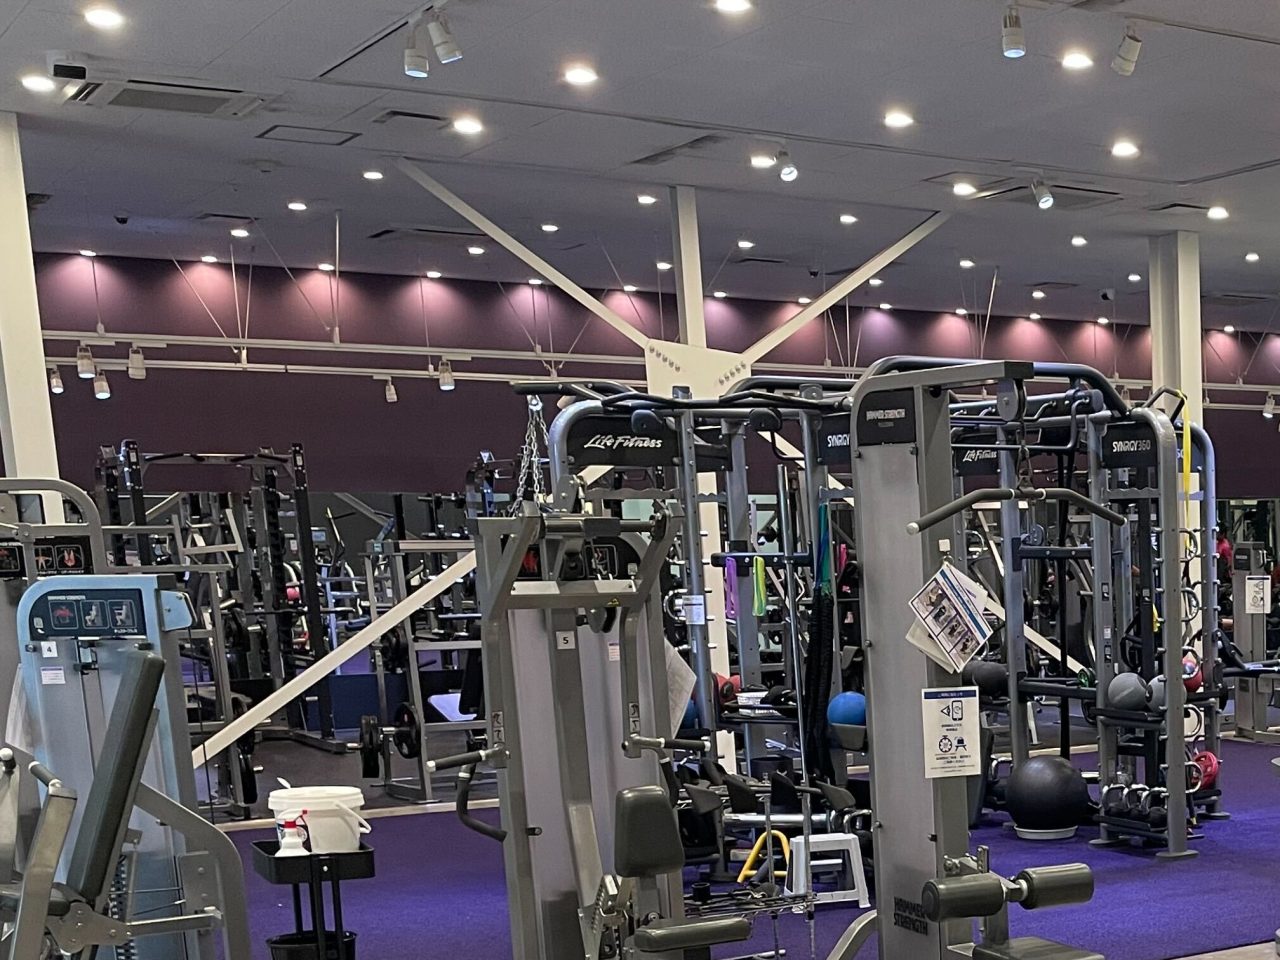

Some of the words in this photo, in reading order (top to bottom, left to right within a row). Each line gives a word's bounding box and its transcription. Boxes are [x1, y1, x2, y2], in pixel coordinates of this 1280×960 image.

[584, 435, 615, 449] Life
[613, 436, 662, 449] Fitness
[563, 636, 569, 645] 5
